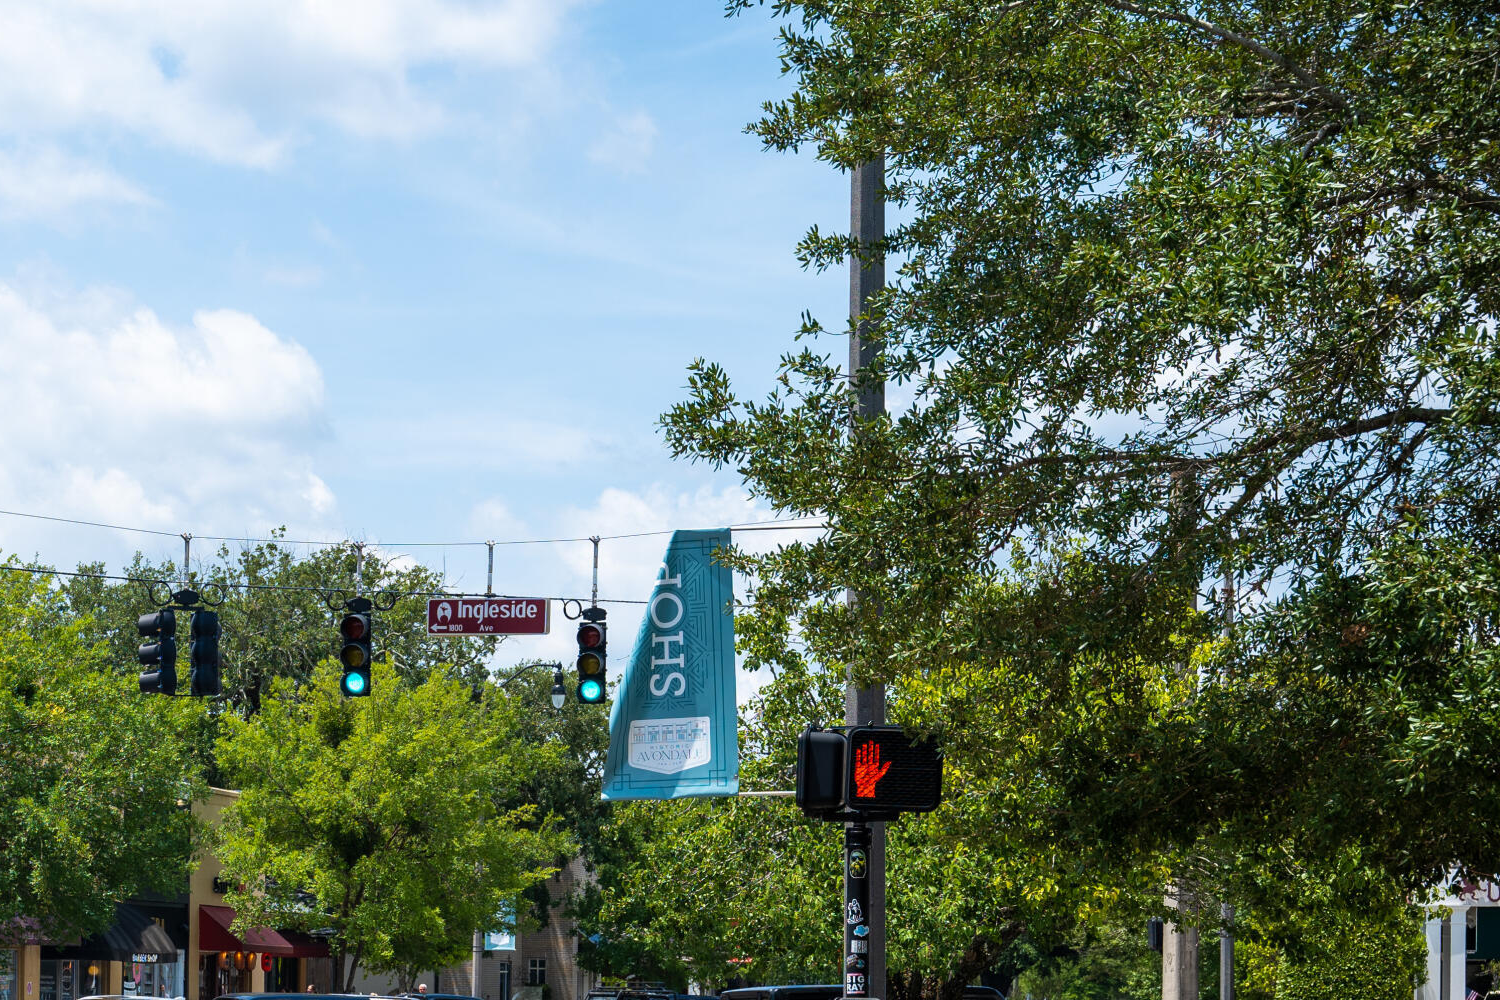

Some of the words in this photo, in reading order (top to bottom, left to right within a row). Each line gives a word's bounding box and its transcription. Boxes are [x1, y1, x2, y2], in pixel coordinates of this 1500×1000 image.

[457, 600, 538, 624] Ingleside
[449, 624, 463, 632] 1800
[479, 624, 494, 632] Ave
